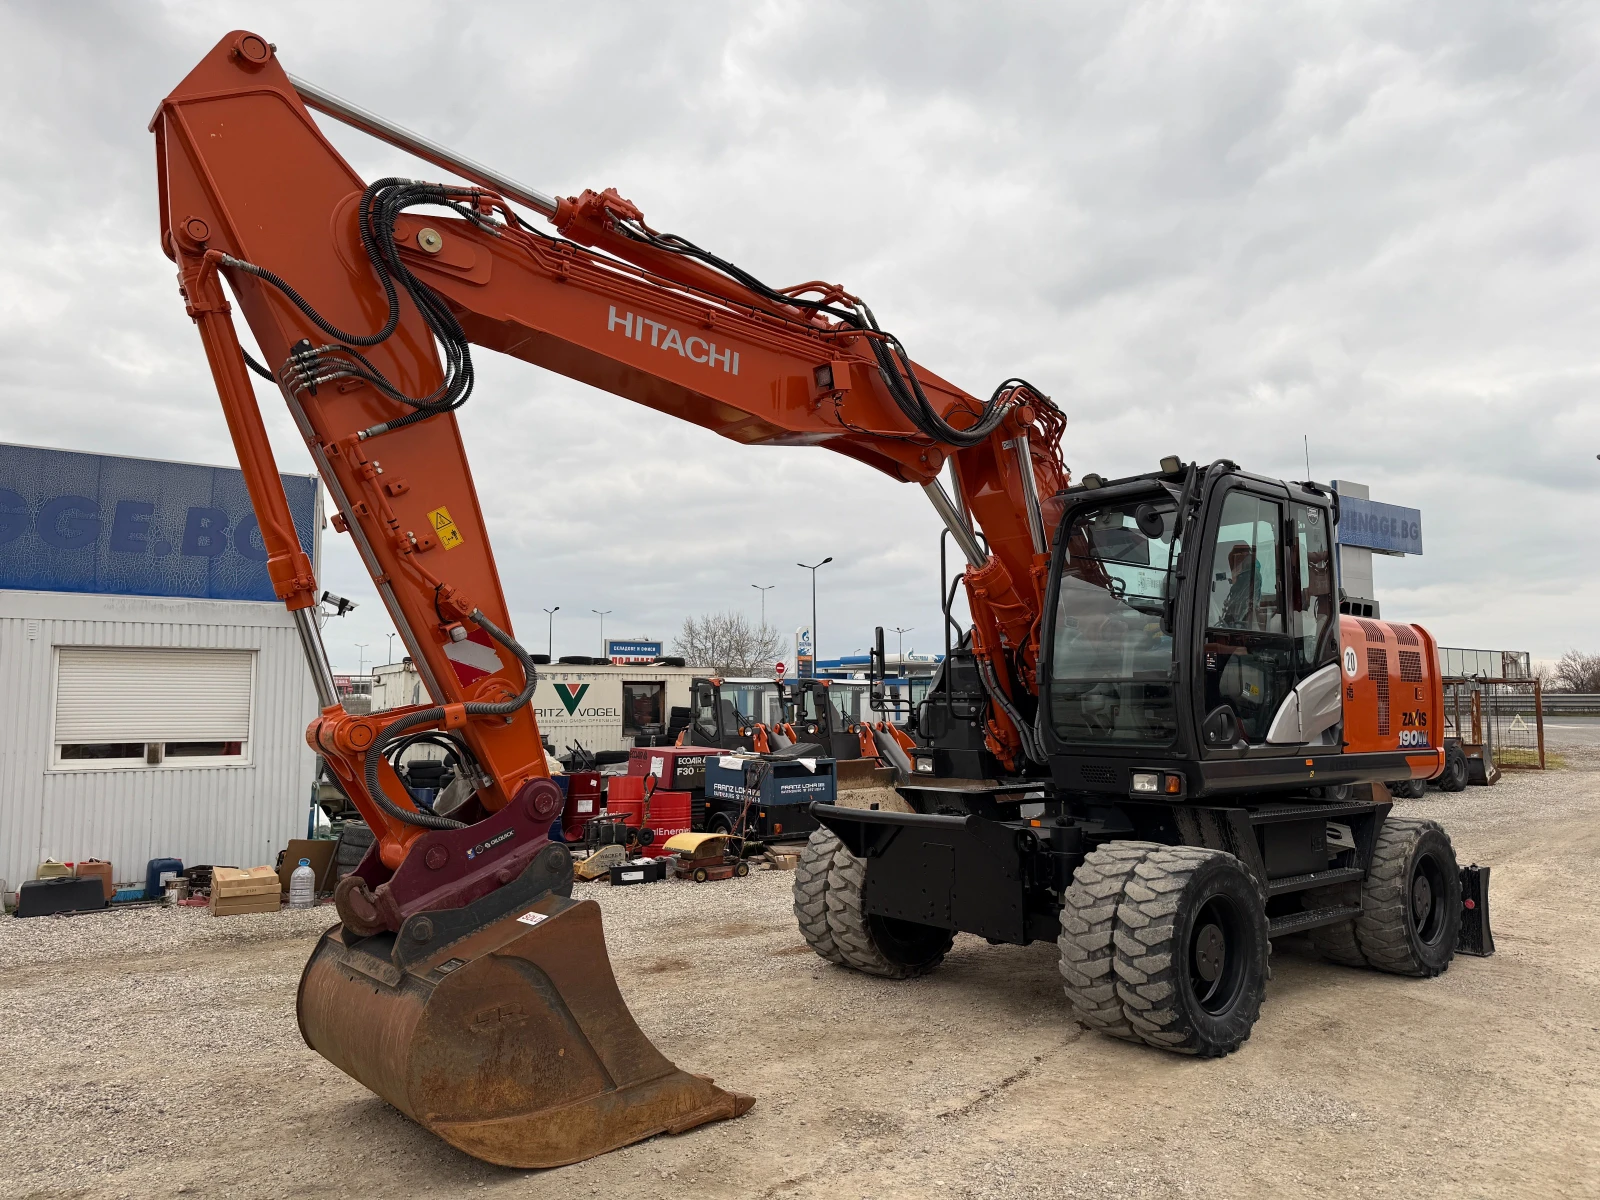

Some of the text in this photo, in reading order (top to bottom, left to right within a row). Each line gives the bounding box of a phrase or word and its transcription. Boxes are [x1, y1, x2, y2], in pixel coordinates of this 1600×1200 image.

[608, 304, 739, 376] HITACHI
[1345, 651, 1356, 672] 20
[578, 707, 621, 717] VOGEL
[1402, 709, 1427, 727] ZAXIS
[1398, 730, 1429, 746] 190W
[678, 757, 702, 765] ECOAIR
[676, 767, 694, 776] F30
[713, 783, 734, 793] FRANZ
